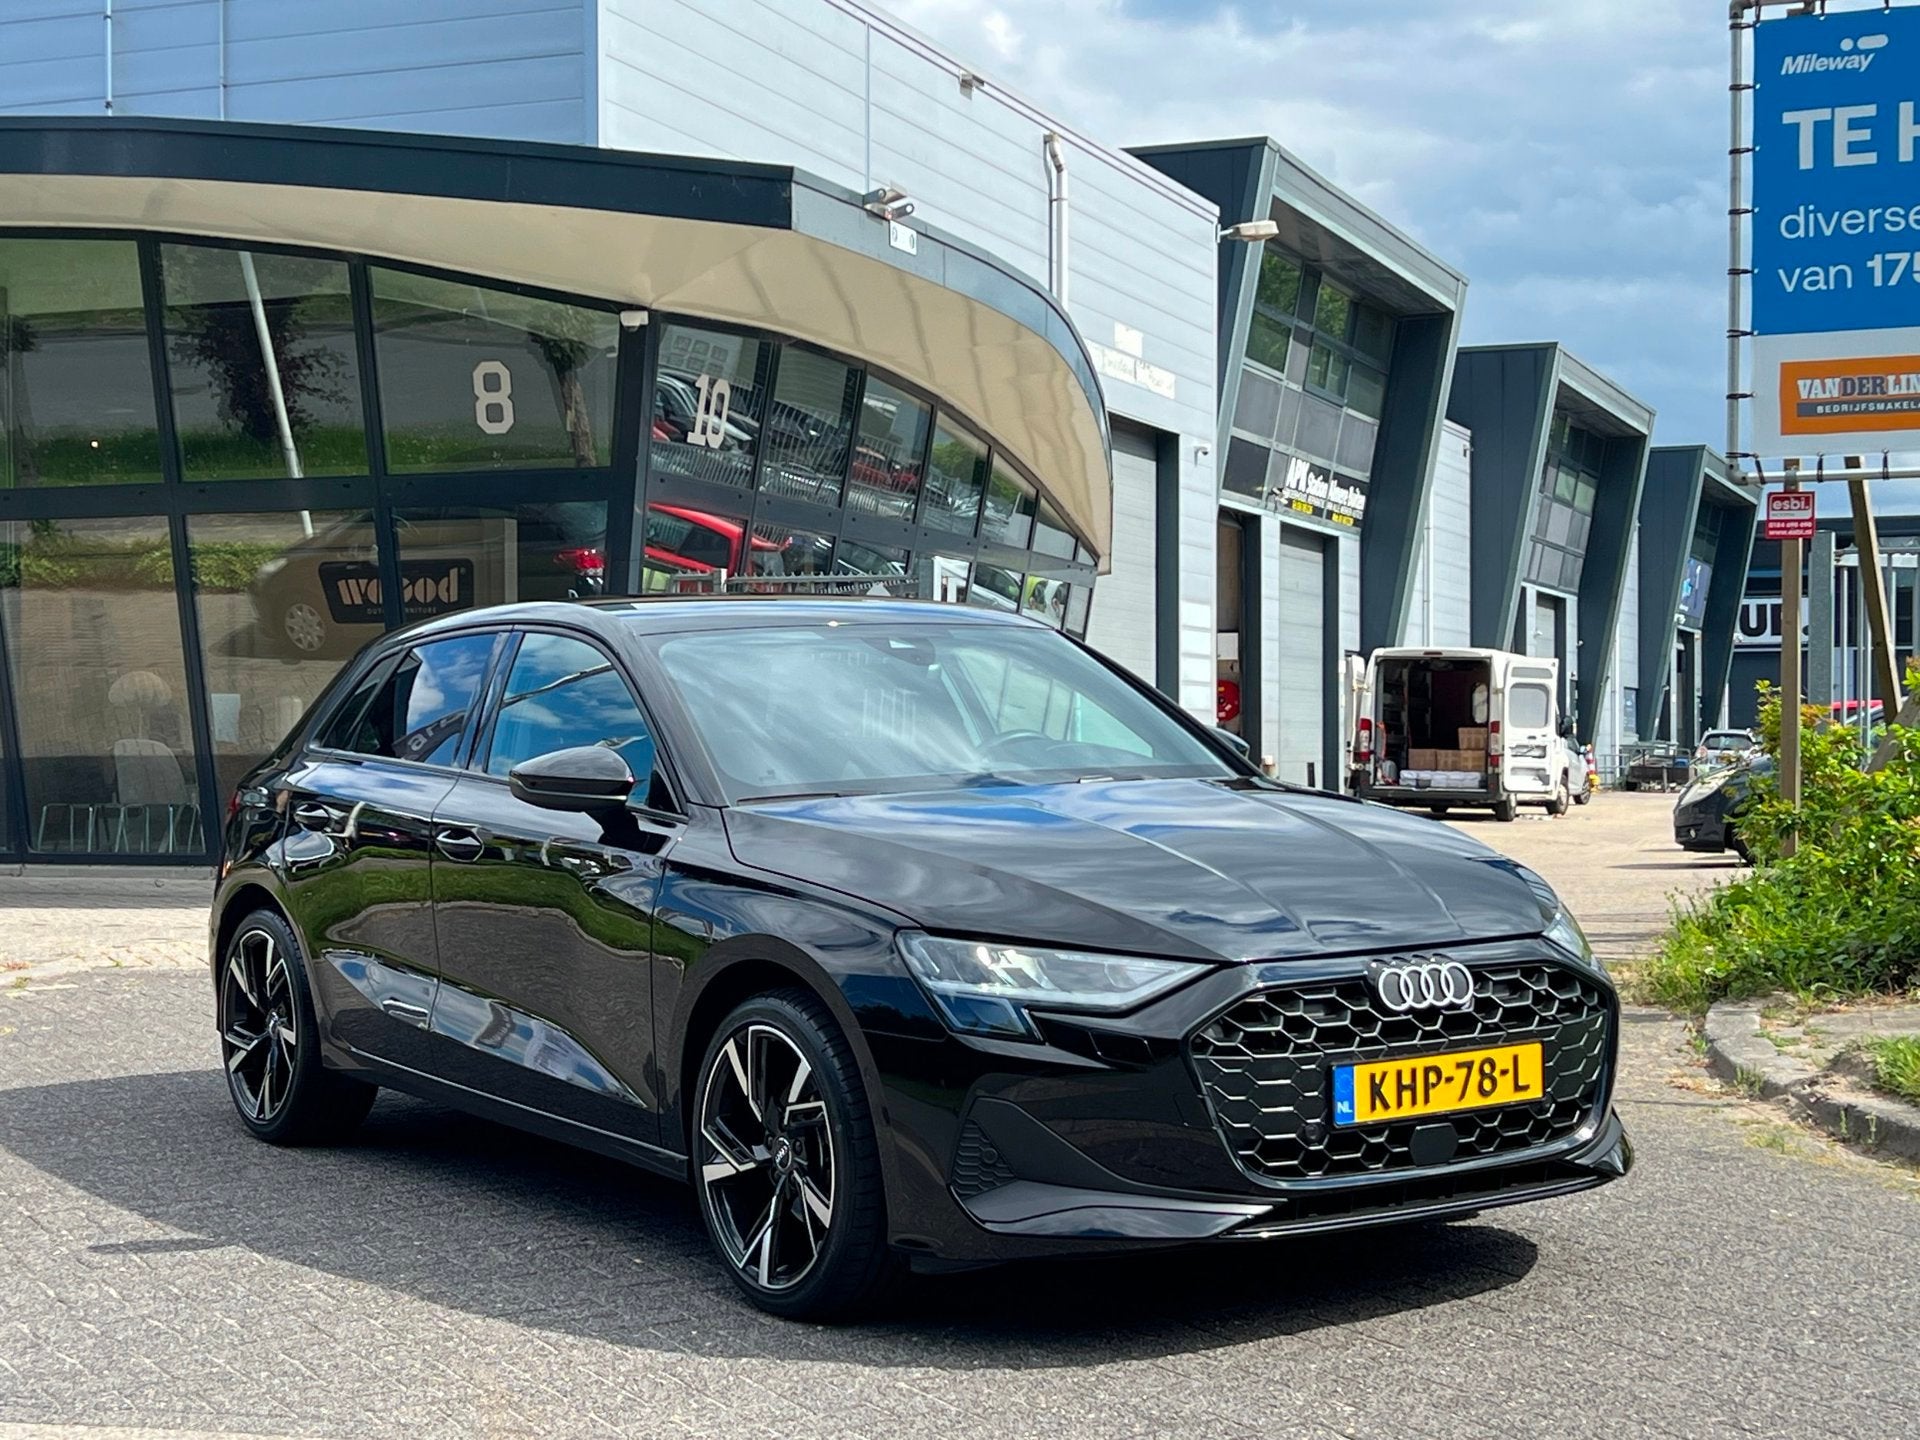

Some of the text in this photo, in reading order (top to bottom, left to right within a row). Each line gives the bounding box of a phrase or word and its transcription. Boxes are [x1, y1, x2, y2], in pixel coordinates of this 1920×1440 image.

[1780, 53, 1876, 75] Mileway
[1782, 103, 1878, 170] TE
[1777, 264, 1853, 293] van
[473, 361, 514, 434] 8
[687, 374, 731, 449] 10
[1336, 1101, 1353, 1114] NL
[1370, 1054, 1531, 1113] KHP-78-L
